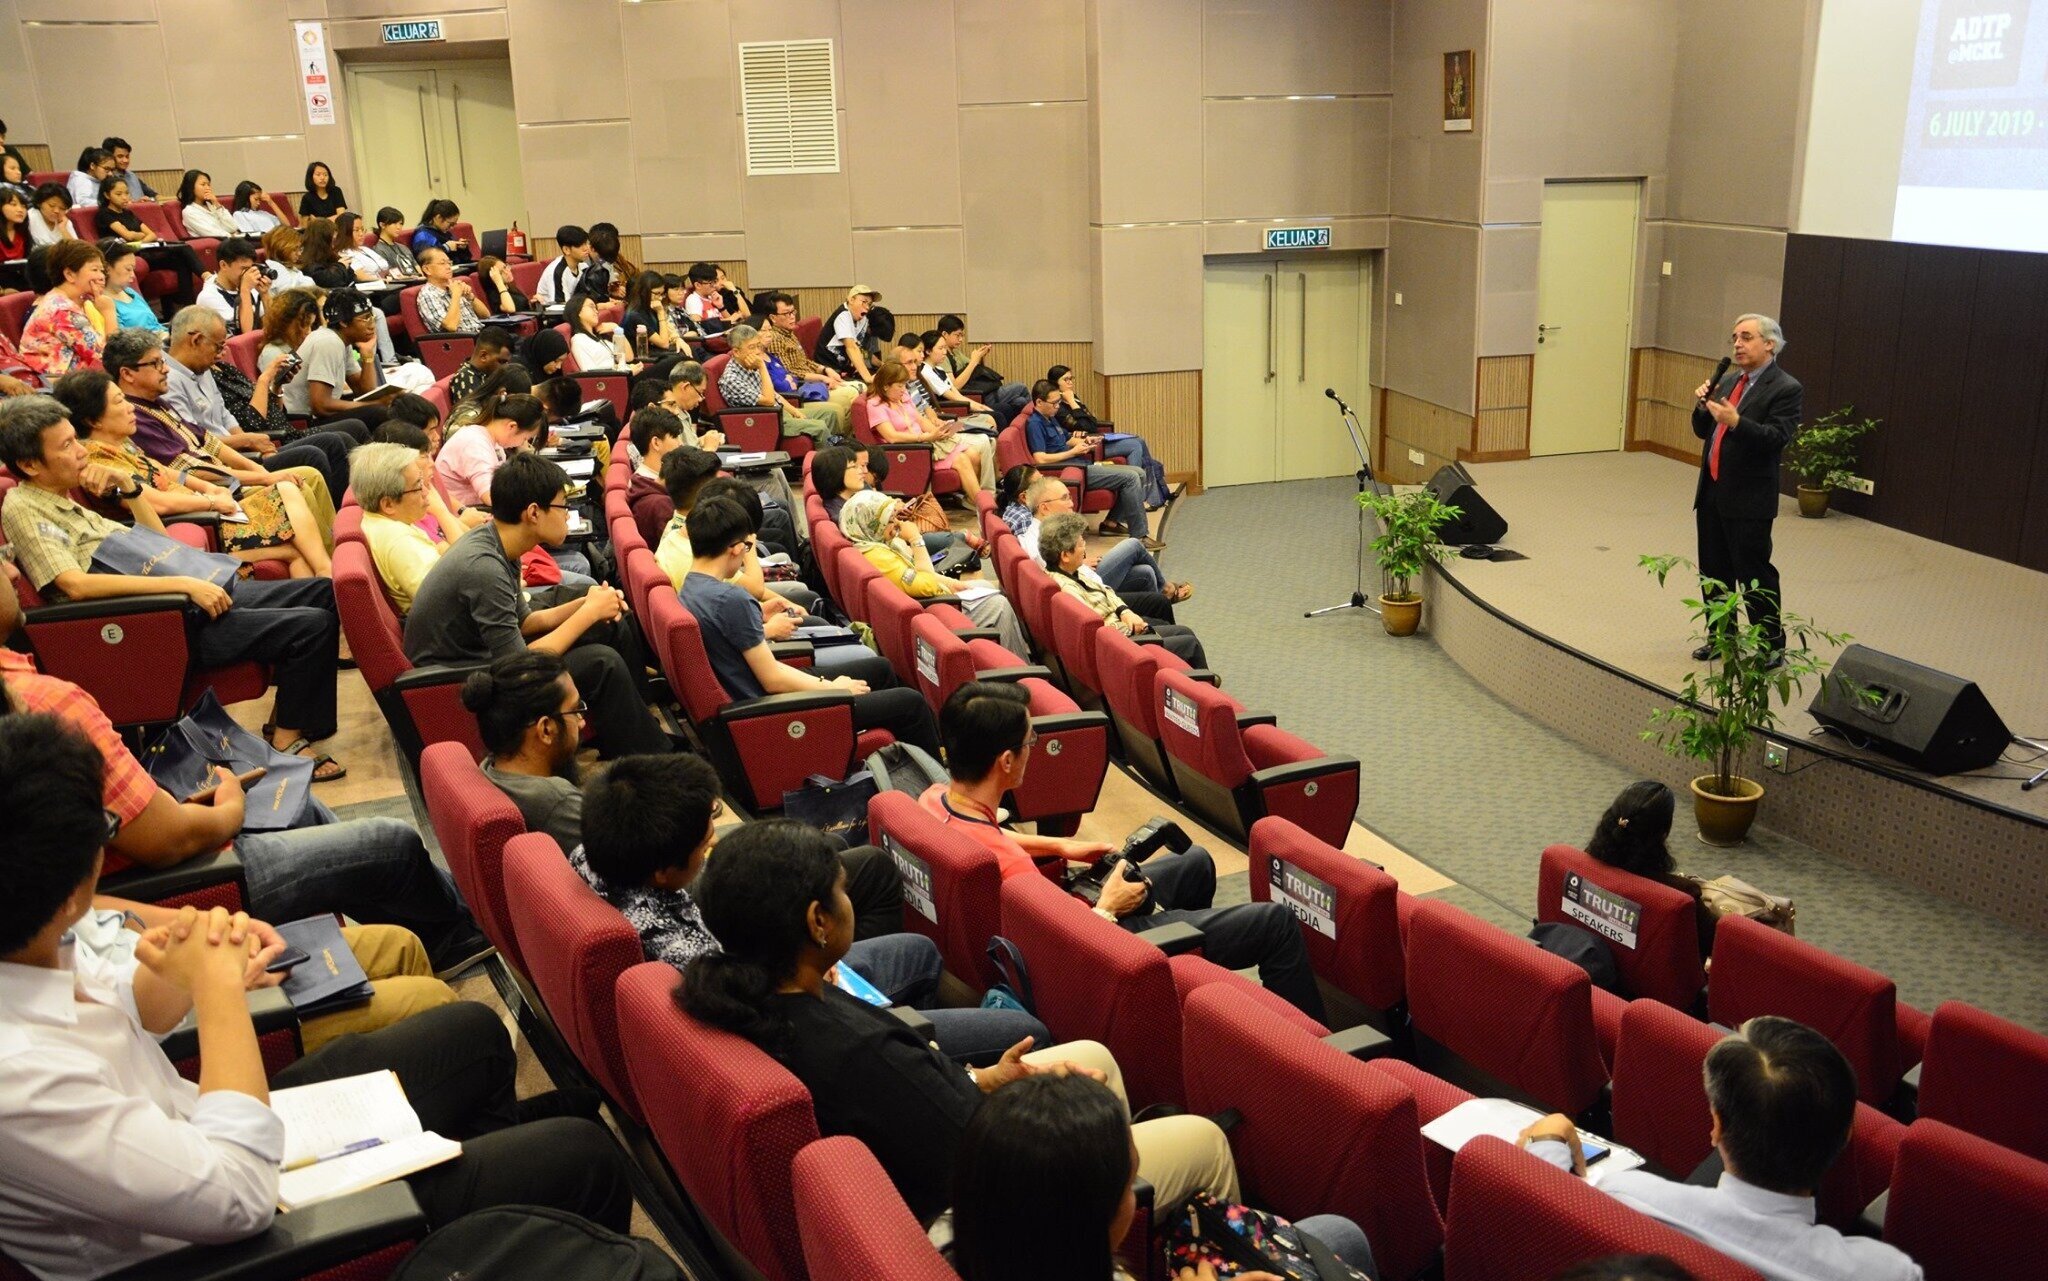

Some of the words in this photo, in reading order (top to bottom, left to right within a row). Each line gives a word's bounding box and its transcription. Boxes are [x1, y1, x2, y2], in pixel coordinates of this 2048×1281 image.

[384, 24, 428, 40] KELUAR
[1950, 13, 2011, 42] ADTP
[1930, 112, 1941, 137] 6
[1943, 110, 1985, 137] JULY
[1986, 109, 2035, 136] 2019
[1268, 230, 1316, 247] KELUAR
[107, 629, 117, 639] E
[1172, 696, 1196, 720] TRUTH
[792, 725, 801, 735] C
[1307, 785, 1315, 793] A
[891, 849, 930, 891] TRUTH
[1286, 871, 1331, 911] TRUTH
[1583, 889, 1635, 926] TRUTH
[1572, 907, 1624, 943] SPEAKERS
